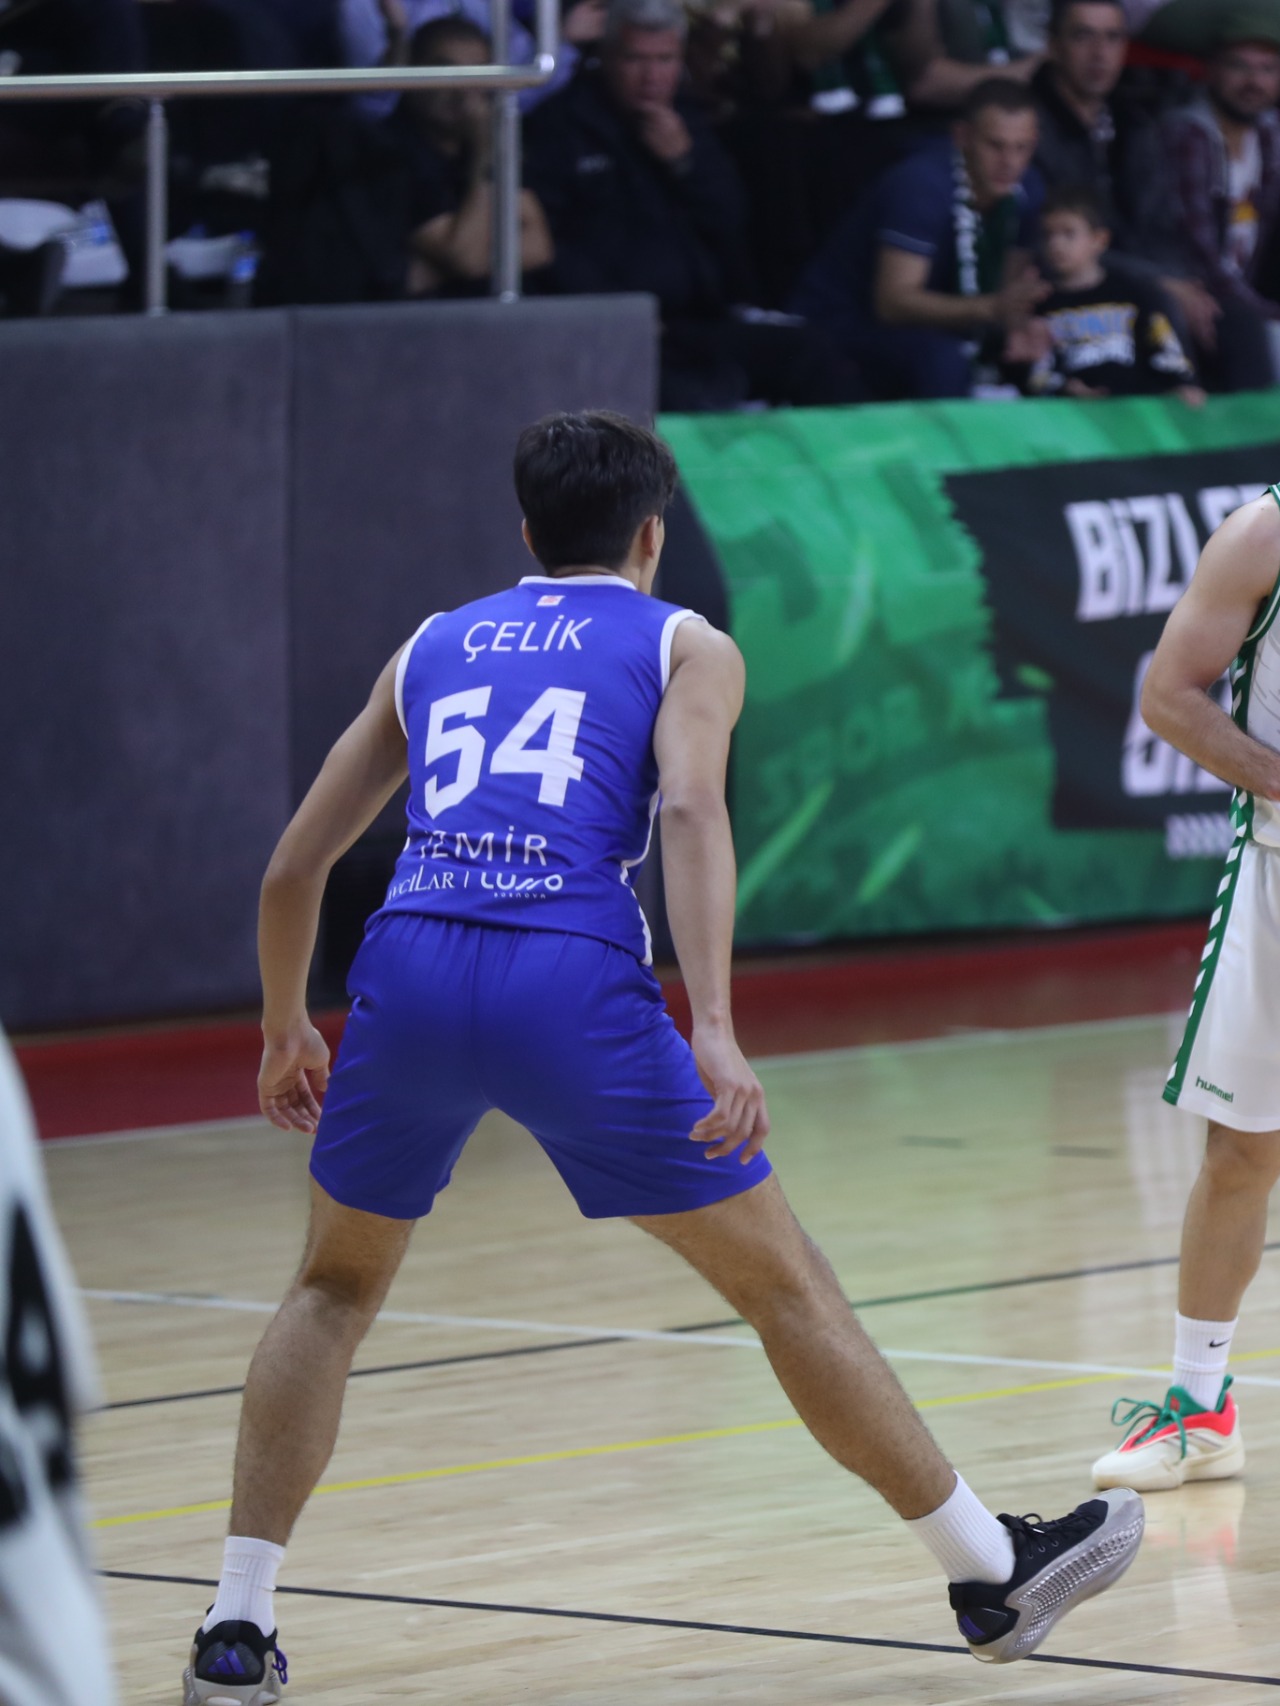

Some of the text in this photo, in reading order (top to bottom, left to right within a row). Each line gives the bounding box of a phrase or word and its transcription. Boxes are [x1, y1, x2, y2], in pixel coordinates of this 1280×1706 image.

[463, 615, 592, 663] ÇELİK
[424, 685, 587, 820] 54
[1195, 1075, 1234, 1103] hummel
